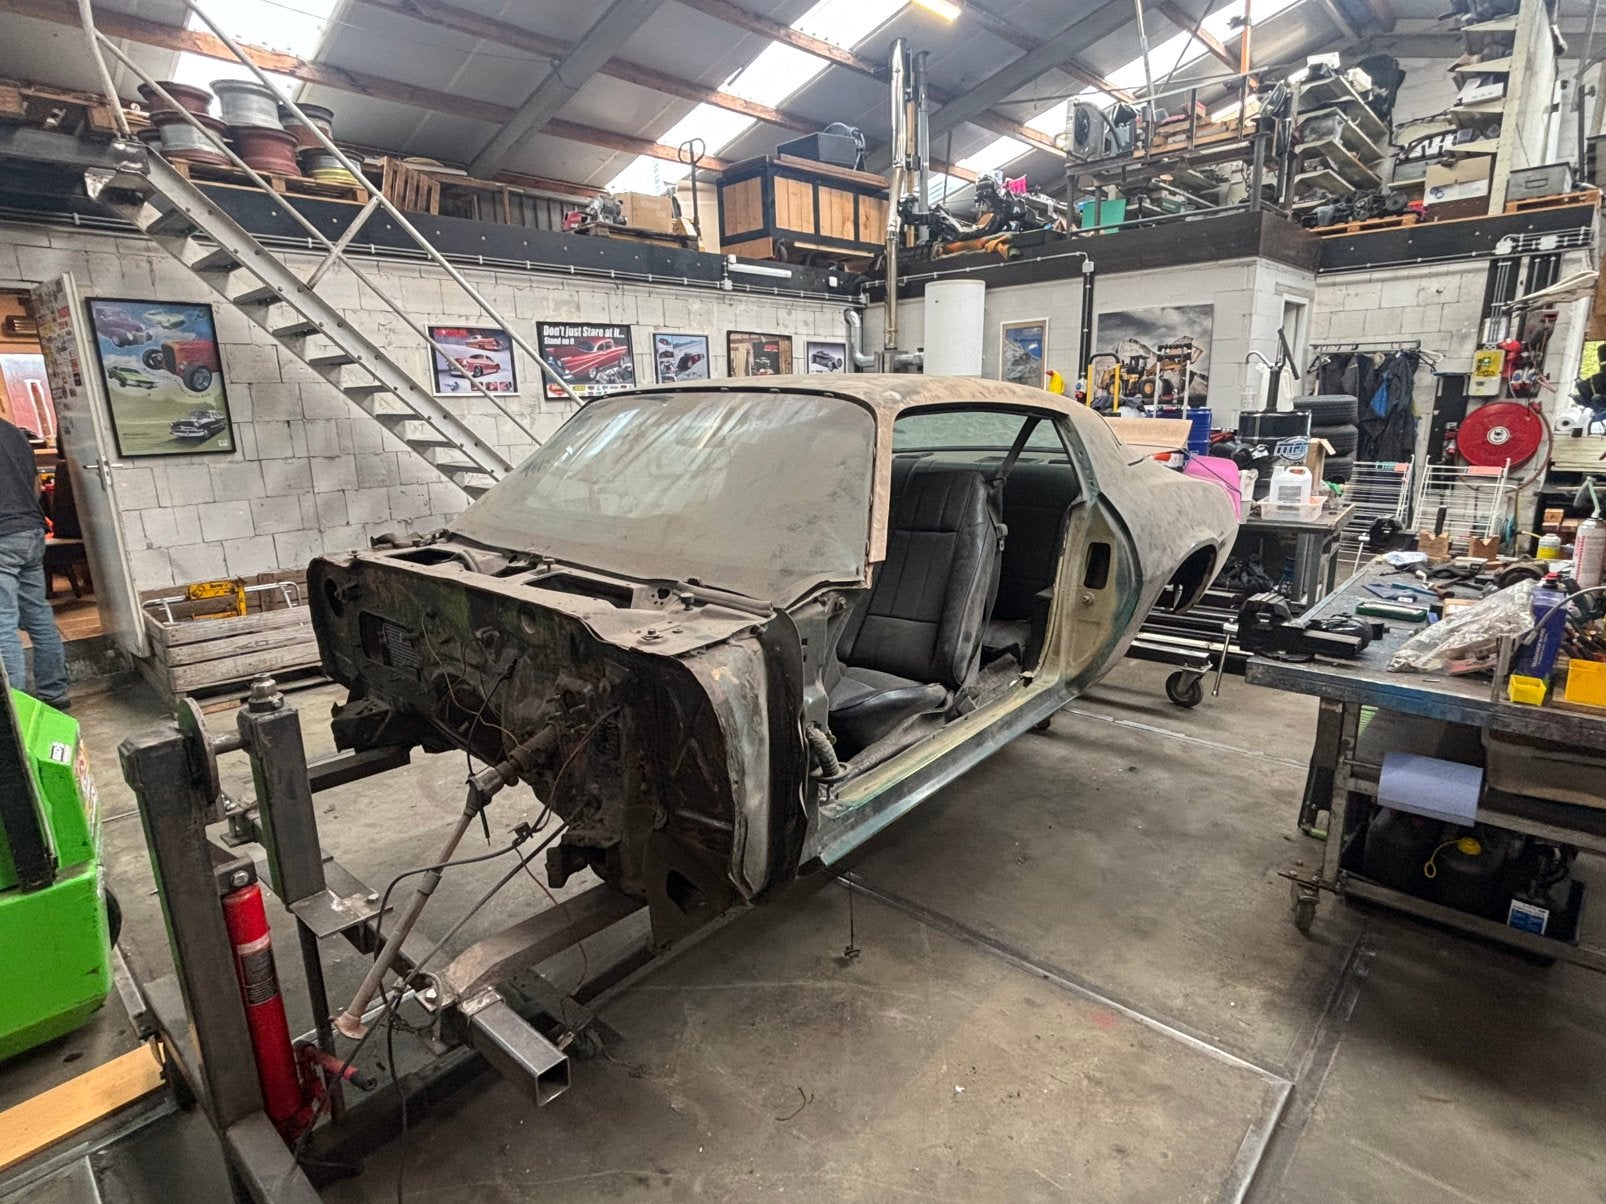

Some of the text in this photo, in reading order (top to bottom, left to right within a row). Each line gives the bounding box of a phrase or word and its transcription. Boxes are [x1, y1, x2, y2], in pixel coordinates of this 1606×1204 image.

[543, 325, 565, 336] Don't
[565, 326, 582, 337] just
[582, 326, 604, 337] Stare
[605, 327, 613, 337] at
[543, 337, 561, 345] Stand
[569, 337, 575, 345] it
